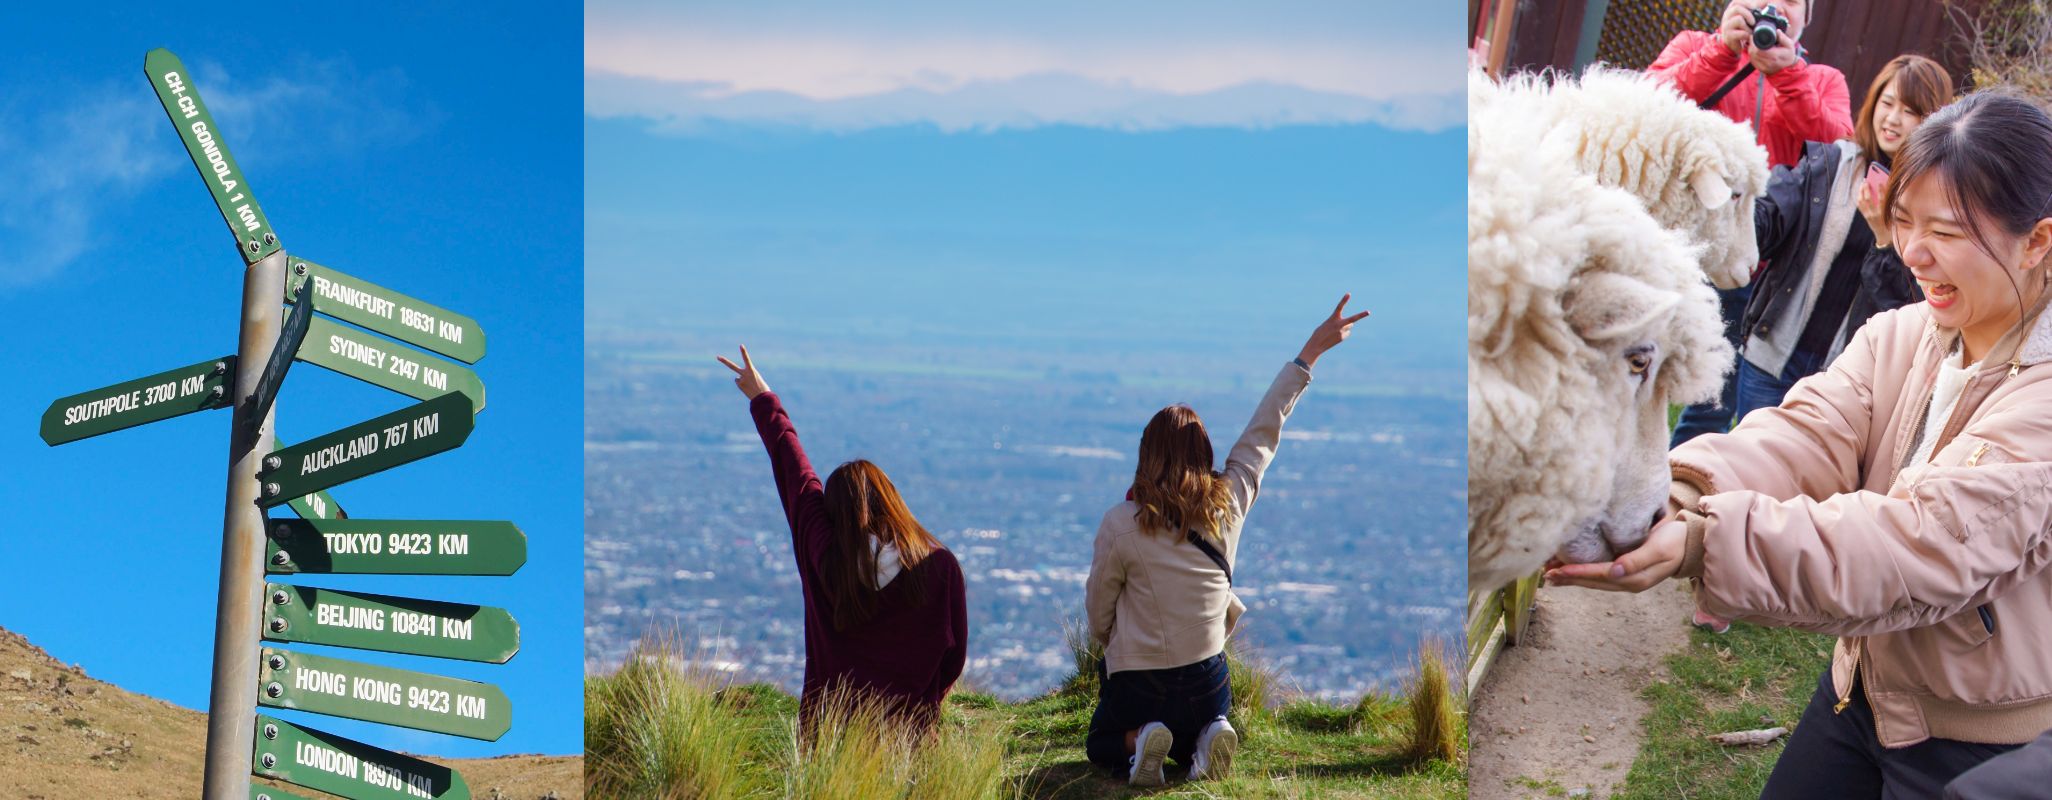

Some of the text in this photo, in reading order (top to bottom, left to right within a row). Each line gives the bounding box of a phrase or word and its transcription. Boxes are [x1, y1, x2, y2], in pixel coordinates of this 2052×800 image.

[164, 71, 261, 232] CH-CH GONDOLA 1 KM
[313, 276, 463, 344] FRANKFURT 18631 KM
[329, 335, 448, 391] SYDNEY 2147 KM
[64, 374, 204, 426] SOUTHPOLE 3700 KM
[301, 412, 439, 476] AUCKLAND 767 KM
[313, 493, 326, 519] KM
[323, 533, 468, 555] TOKYO 9423 KM
[317, 603, 472, 640] BEIJING 10841 KM
[295, 667, 486, 720] HONG KONG 9423 KM
[296, 741, 432, 799] LONDON 18970 KM
